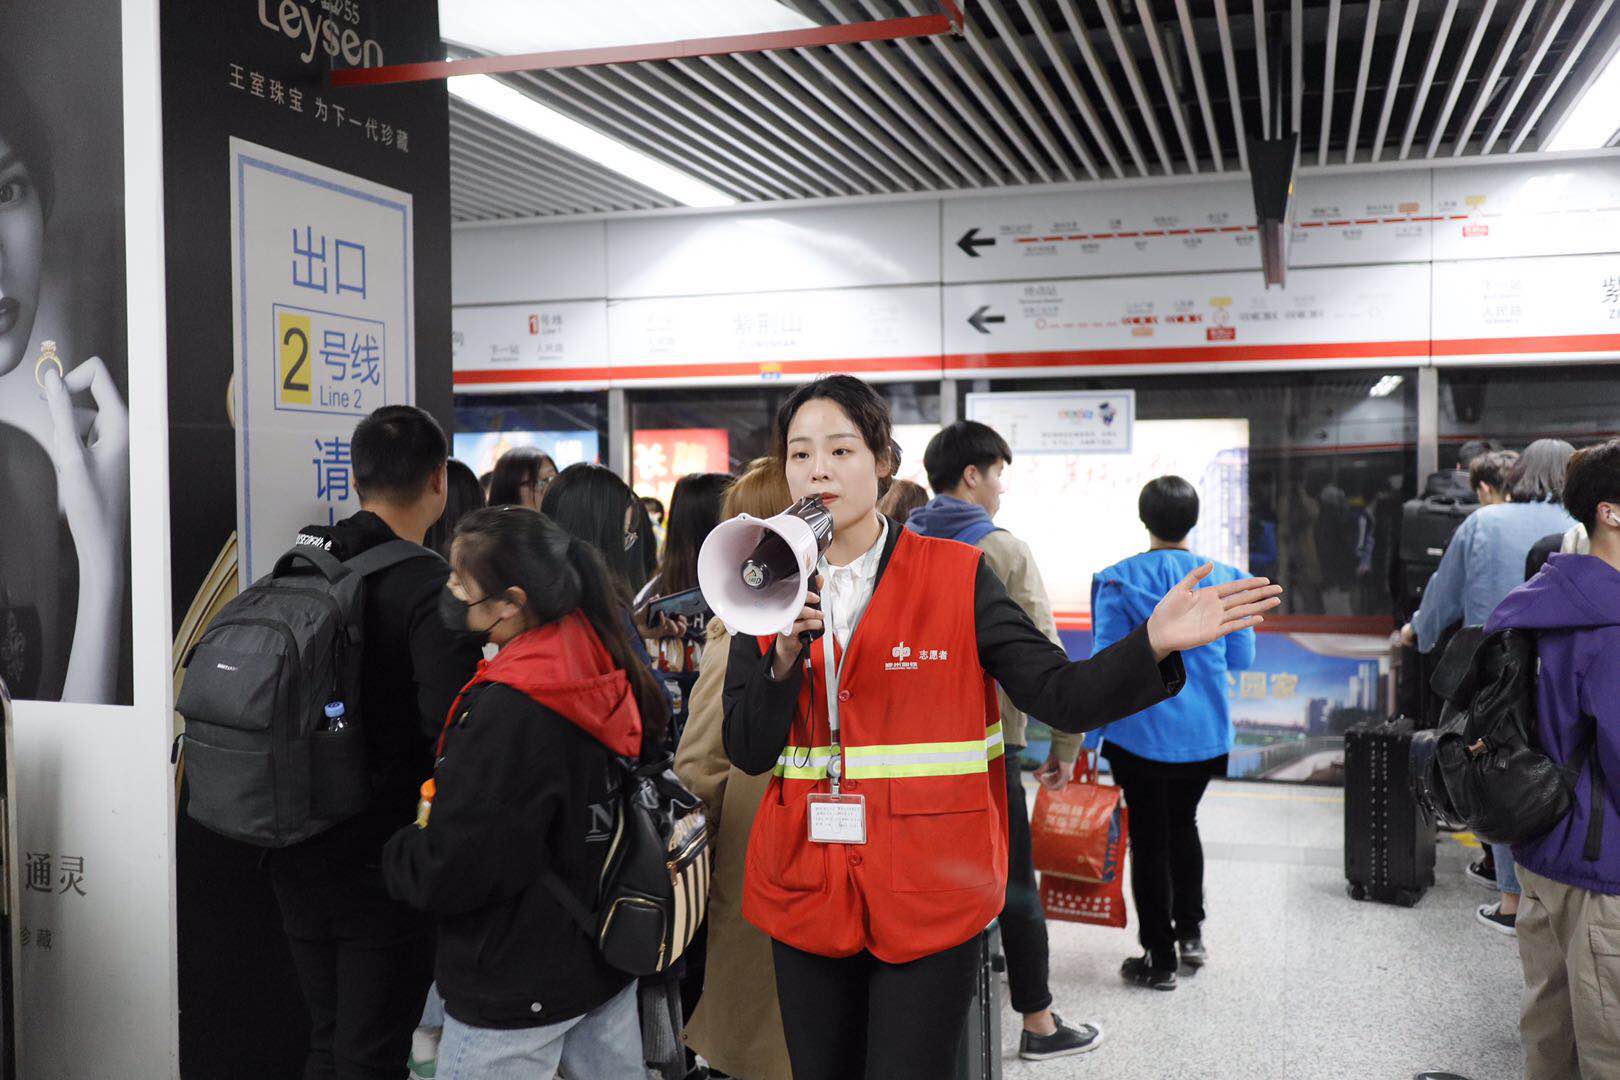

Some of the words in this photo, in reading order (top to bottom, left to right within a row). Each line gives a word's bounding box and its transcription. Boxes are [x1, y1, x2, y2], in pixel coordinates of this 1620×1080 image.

[258, 0, 384, 69] Leysen
[229, 63, 304, 113] 王室珠宝
[315, 97, 409, 153] 为下一代珍藏
[292, 226, 366, 300] 出口
[320, 385, 349, 408] Line
[353, 389, 363, 408] 2
[919, 649, 948, 661] 志愿者
[25, 852, 88, 897] 通灵
